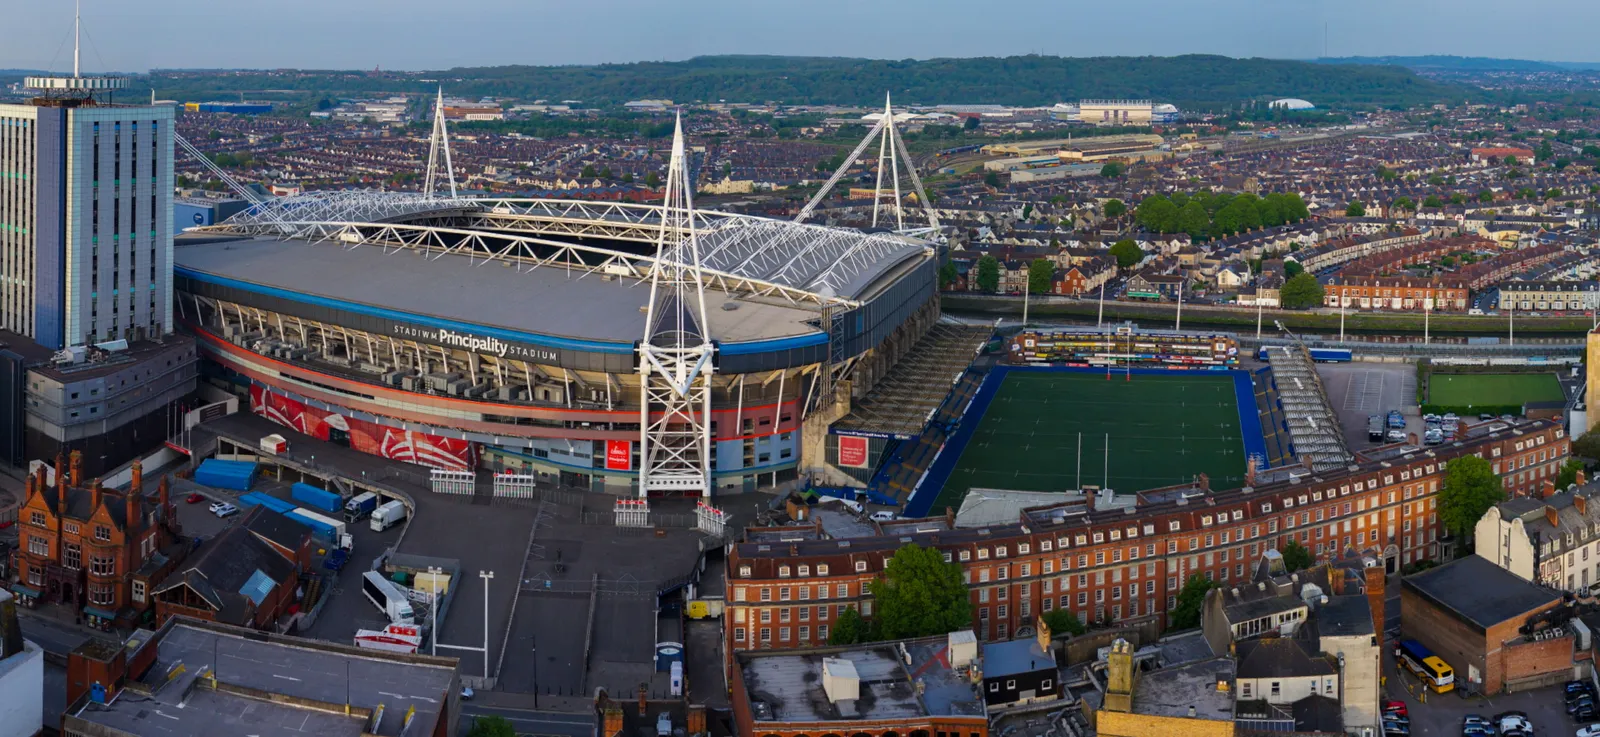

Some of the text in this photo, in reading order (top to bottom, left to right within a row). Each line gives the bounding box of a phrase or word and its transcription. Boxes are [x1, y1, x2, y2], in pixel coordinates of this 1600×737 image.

[394, 325, 557, 361] STADIWM Principality STADIUM
